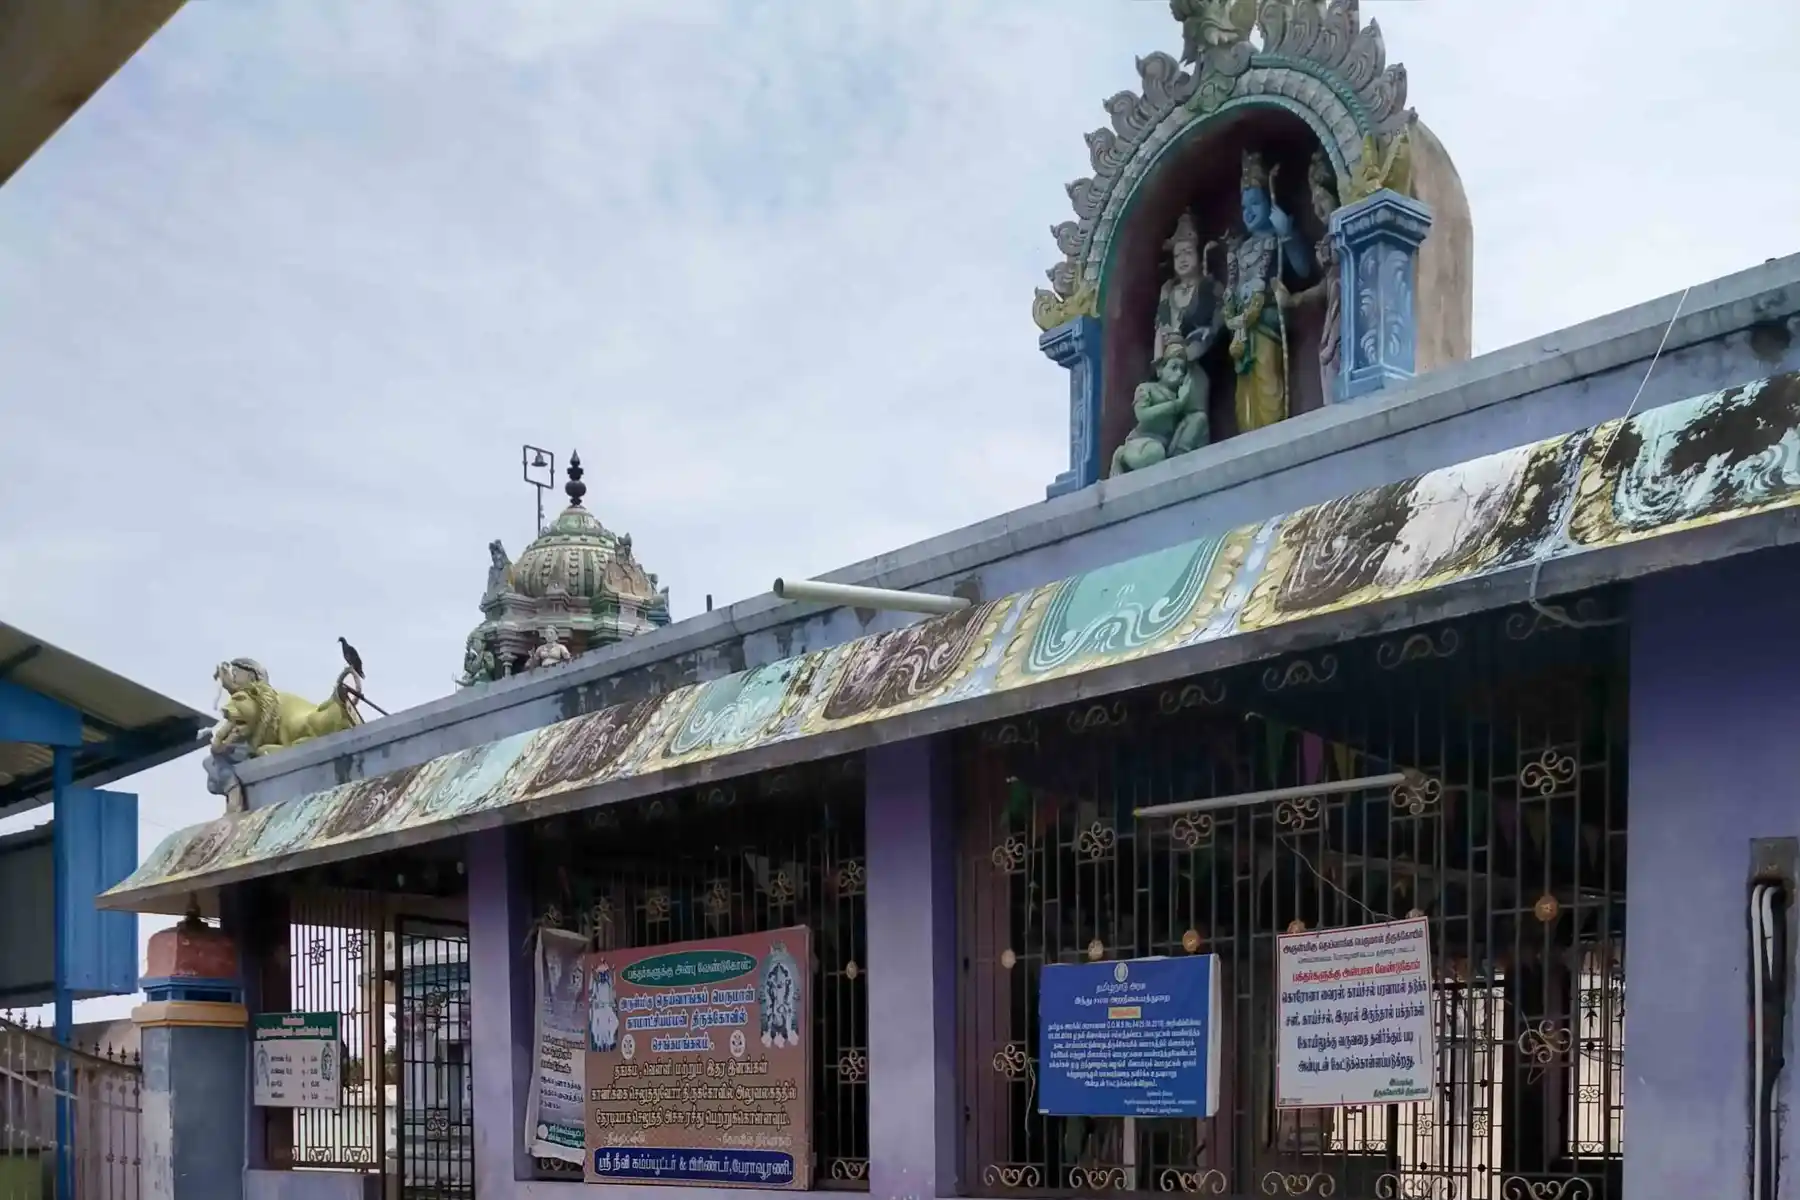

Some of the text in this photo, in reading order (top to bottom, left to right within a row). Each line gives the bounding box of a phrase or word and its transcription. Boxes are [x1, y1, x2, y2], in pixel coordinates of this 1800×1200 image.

[628, 964, 673, 982] பக்தர்களுக்கு
[675, 962, 696, 976] அன்பு
[1292, 958, 1421, 982] பக்தர்களுக்கு அன்பான வேண்டுகோள்
[619, 993, 653, 1012] அருள்மிகு
[712, 984, 755, 1007] பெருமாள்
[1282, 976, 1427, 1003] கொரோனா வைரஸ் காய்ச்சல் பரவாமல் தடுக்க
[626, 1006, 748, 1030] காமாட்சியம்மன் திருக்கோவில்
[1335, 1007, 1359, 1026] இருமல்
[1361, 1004, 1394, 1024] இருந்தால்
[1396, 1001, 1424, 1019] பக்தர்கள்
[1298, 1032, 1337, 1052] கோயிலுக்கு
[1338, 1034, 1368, 1048] வருவதை
[1370, 1028, 1402, 1045] தவிர்க்கும்
[643, 1056, 673, 1077] வெள்ளி
[675, 1056, 704, 1081] மற்றும்
[706, 1058, 725, 1078] இதர
[727, 1055, 768, 1078] இனங்கள்
[1298, 1056, 1329, 1074] அன்புடன்
[591, 1081, 628, 1102] காணிக்கை
[681, 1080, 733, 1104] திருக்கோவில்
[736, 1078, 798, 1105] அலுவலகத்தில்
[596, 1108, 632, 1127] நேரடியாக
[633, 1105, 663, 1128] செலுத்தி
[599, 1152, 612, 1171] ஸ்ரீ
[613, 1154, 630, 1171] நீவி
[632, 1153, 676, 1176] கம்ப்யூட்டர்
[679, 1158, 687, 1170] &
